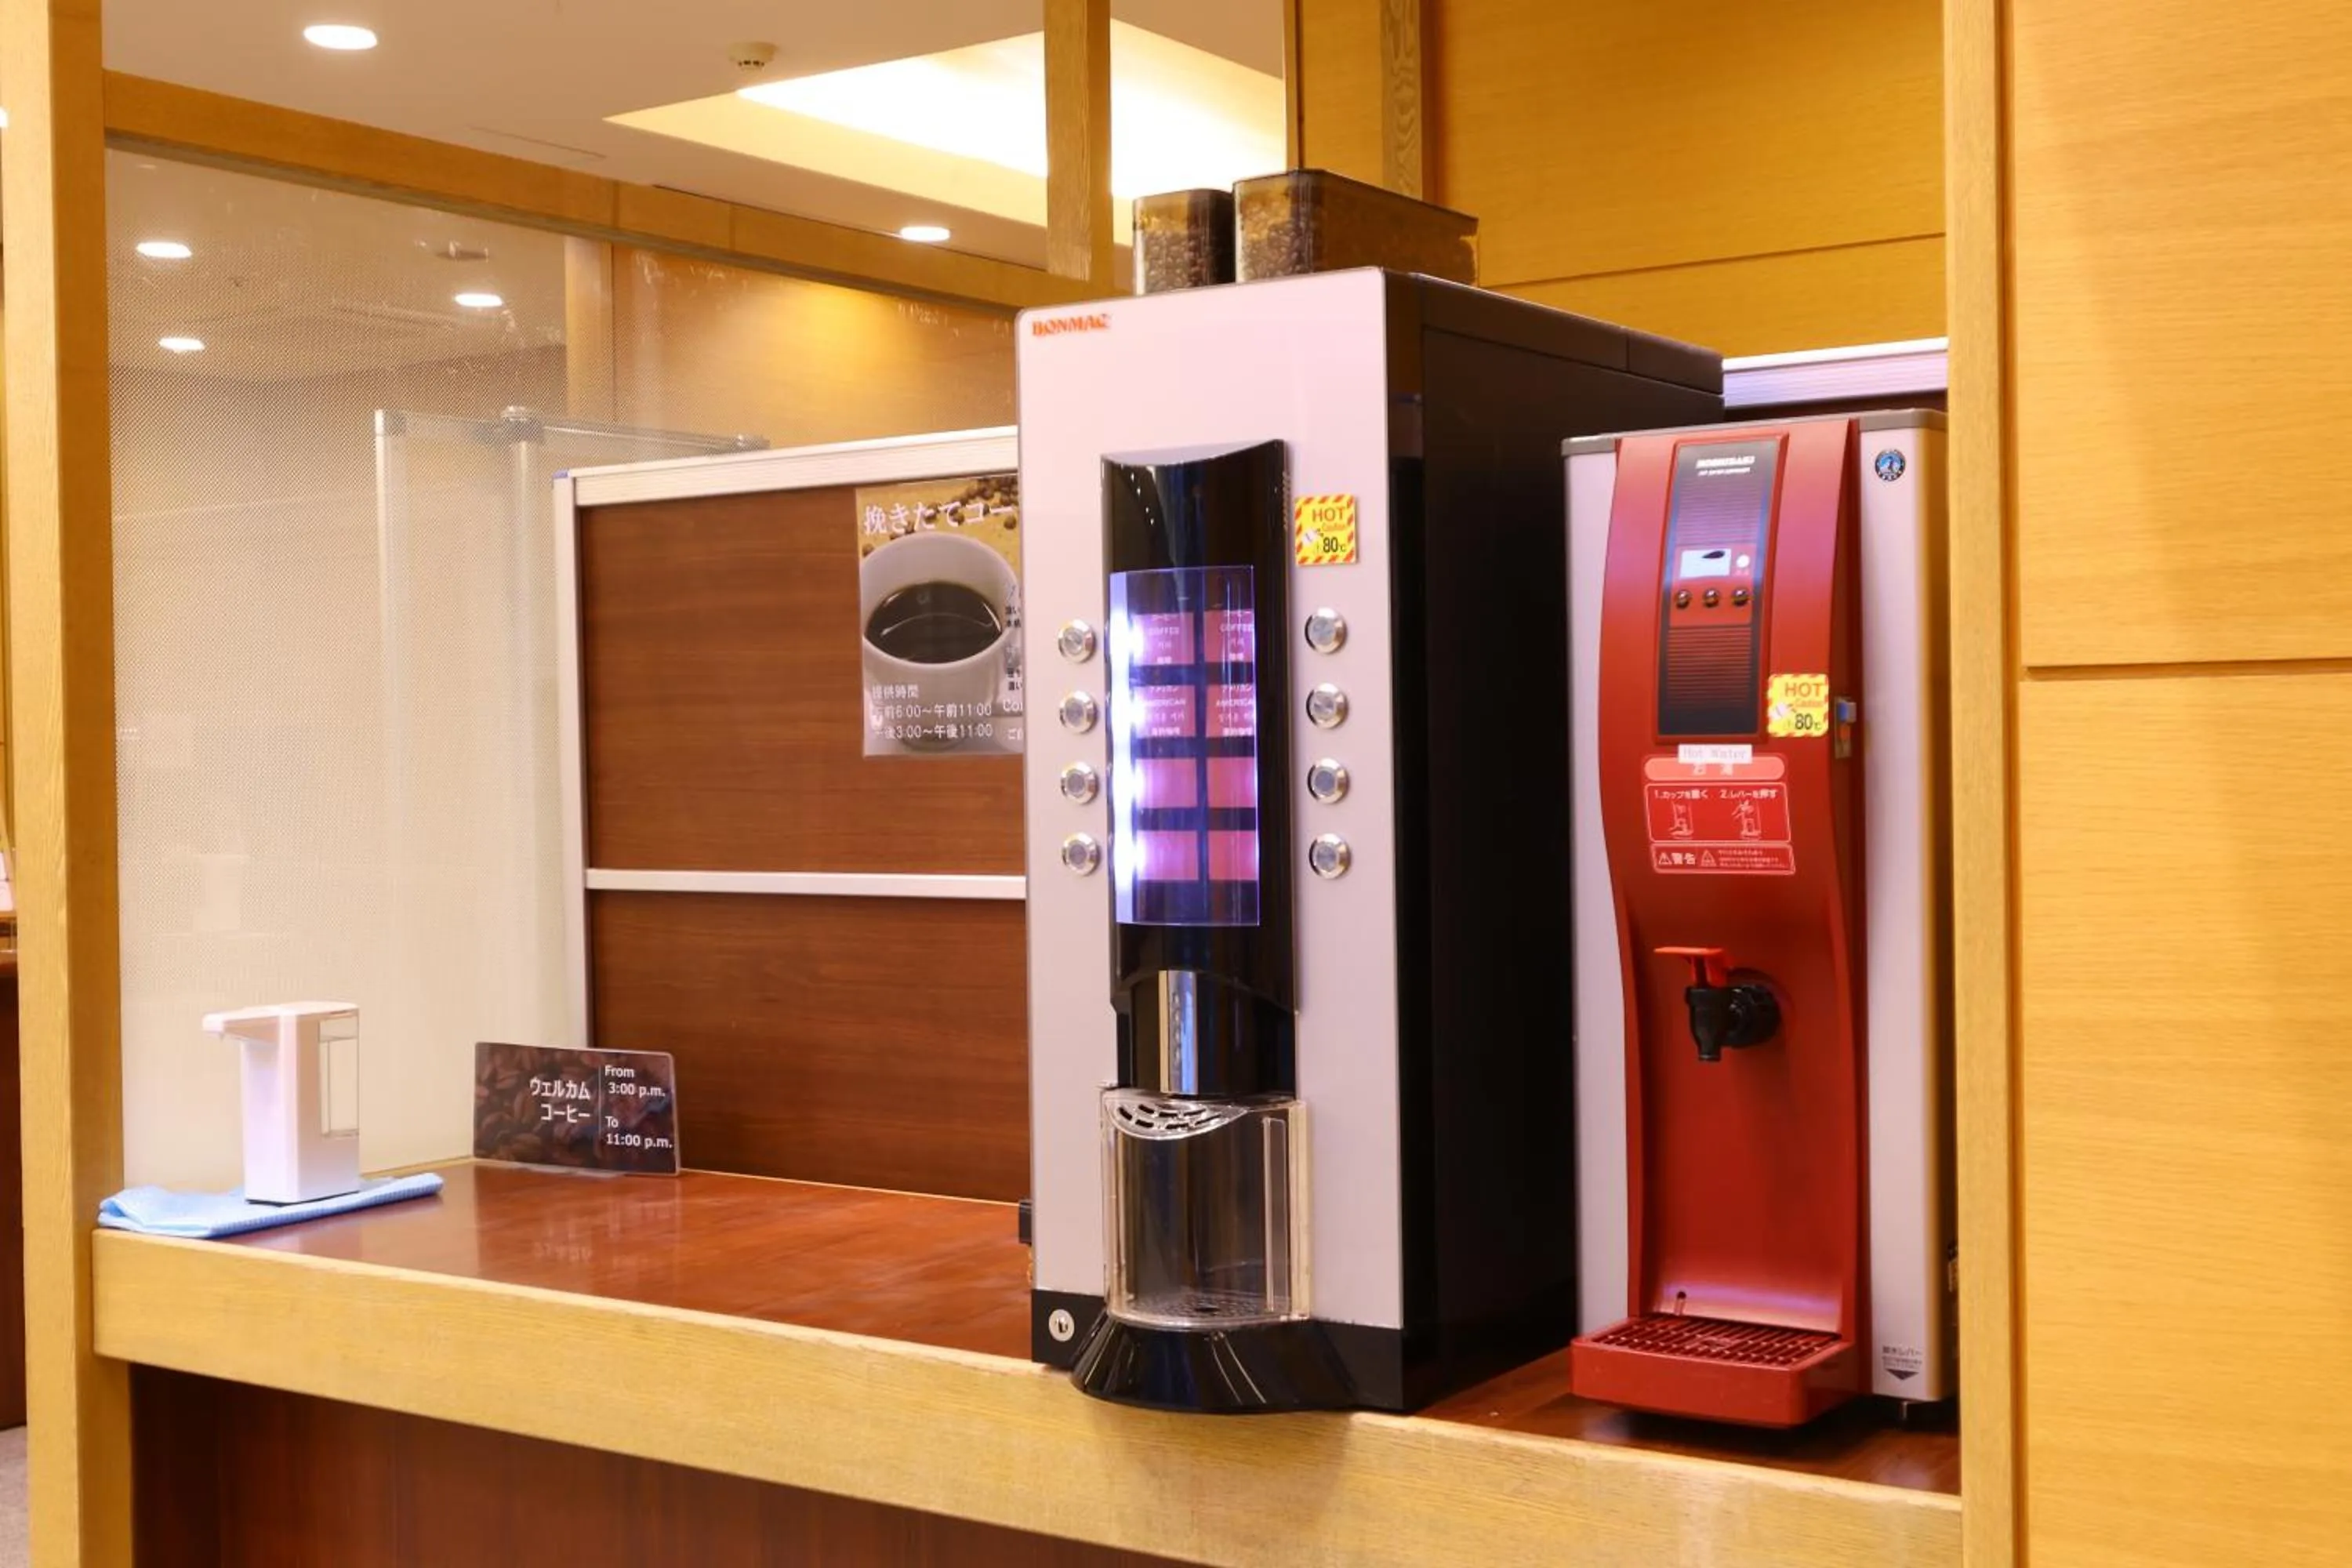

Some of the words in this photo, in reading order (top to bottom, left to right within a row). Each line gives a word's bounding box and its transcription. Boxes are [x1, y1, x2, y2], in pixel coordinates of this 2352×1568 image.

[864, 501, 1013, 535] 挽きたてコー
[1312, 506, 1345, 522] HOT
[1784, 682, 1824, 698] HOT
[604, 1065, 635, 1079] From
[529, 1076, 590, 1100] ウェルカム
[608, 1082, 635, 1095] 3:00
[638, 1086, 666, 1098] p.m.
[541, 1103, 590, 1123] コーヒー
[605, 1116, 619, 1128] To
[606, 1134, 641, 1147] 11:00
[644, 1137, 673, 1149] p.m.
